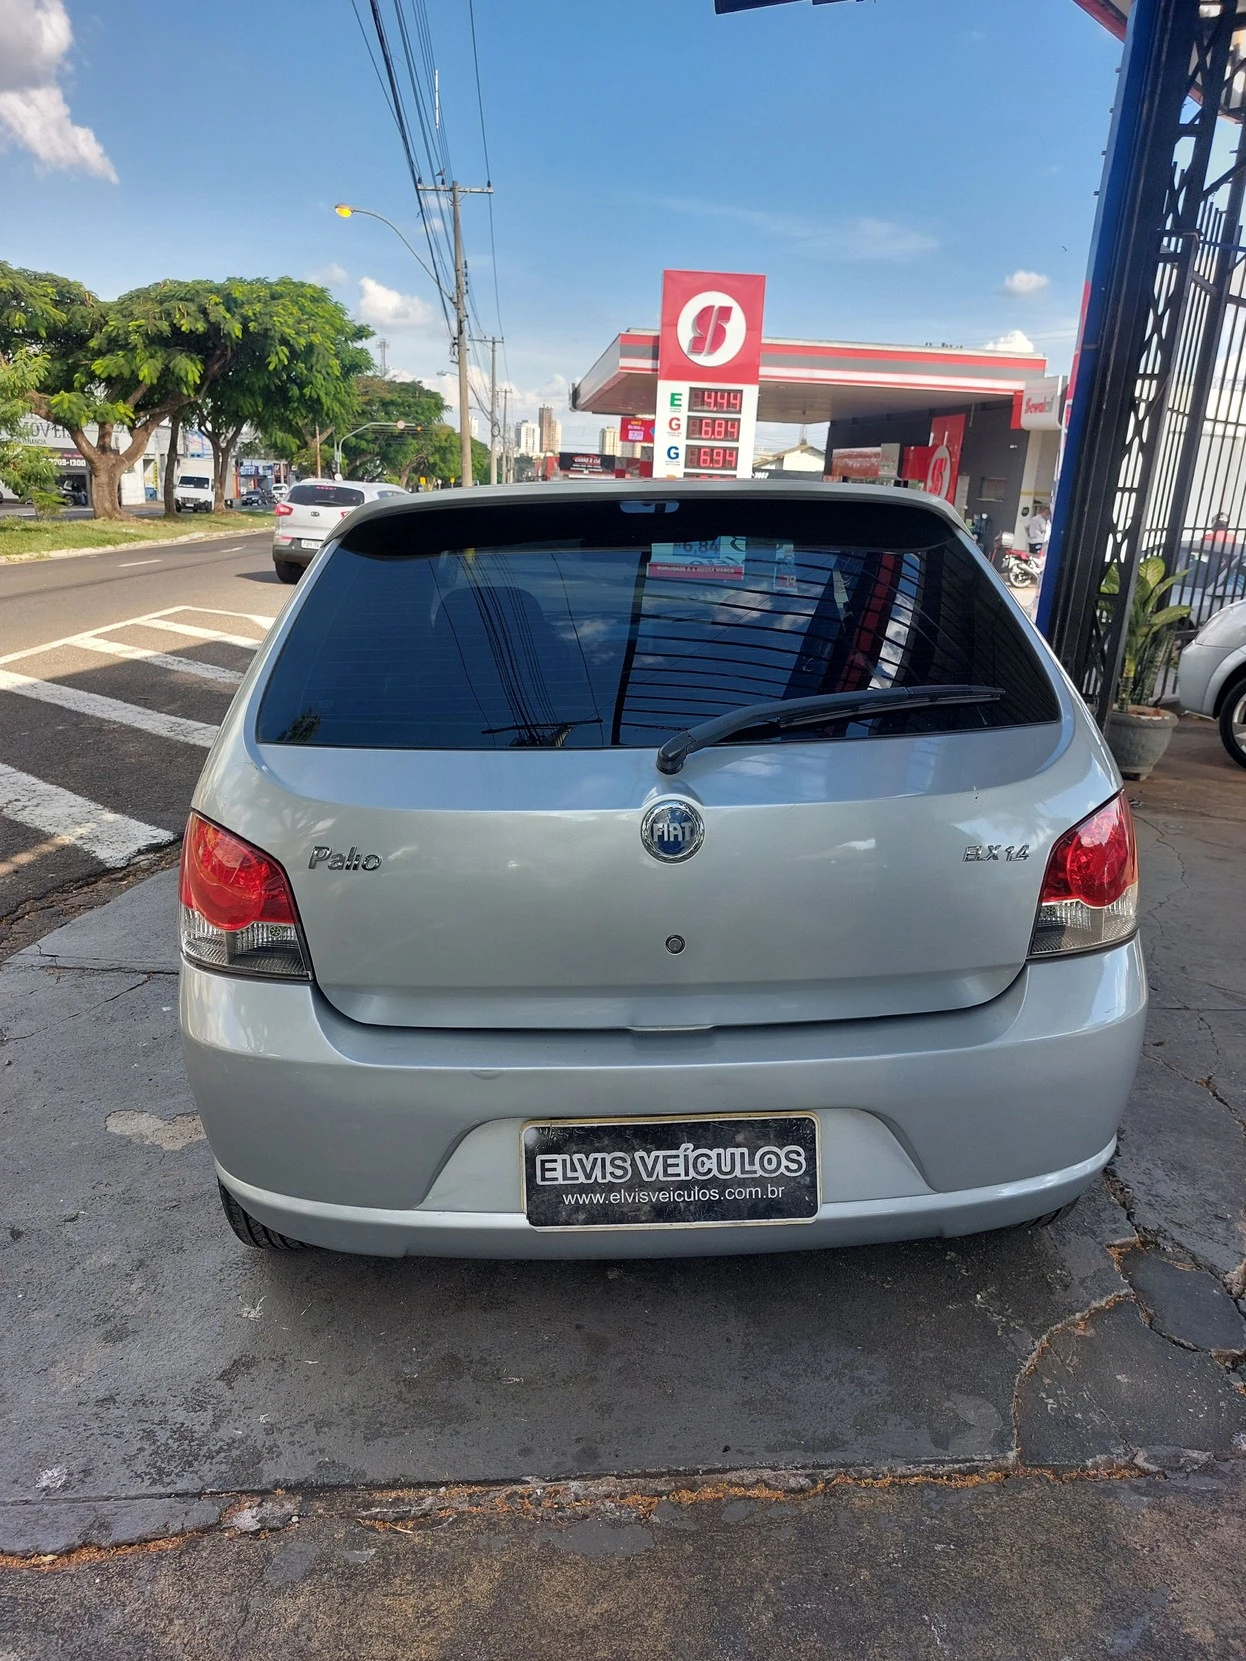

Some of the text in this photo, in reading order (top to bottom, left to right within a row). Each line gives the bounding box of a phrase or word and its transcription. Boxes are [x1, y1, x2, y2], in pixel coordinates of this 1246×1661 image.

[669, 391, 741, 411] E 4,44
[668, 416, 738, 439] G 6,84
[666, 445, 680, 460] G
[652, 822, 693, 842] FIAT
[308, 846, 382, 871] Palio
[535, 1143, 806, 1185] ELVIS VEÍCULOS
[563, 1184, 785, 1205] www.elvisveiculos.com.br
